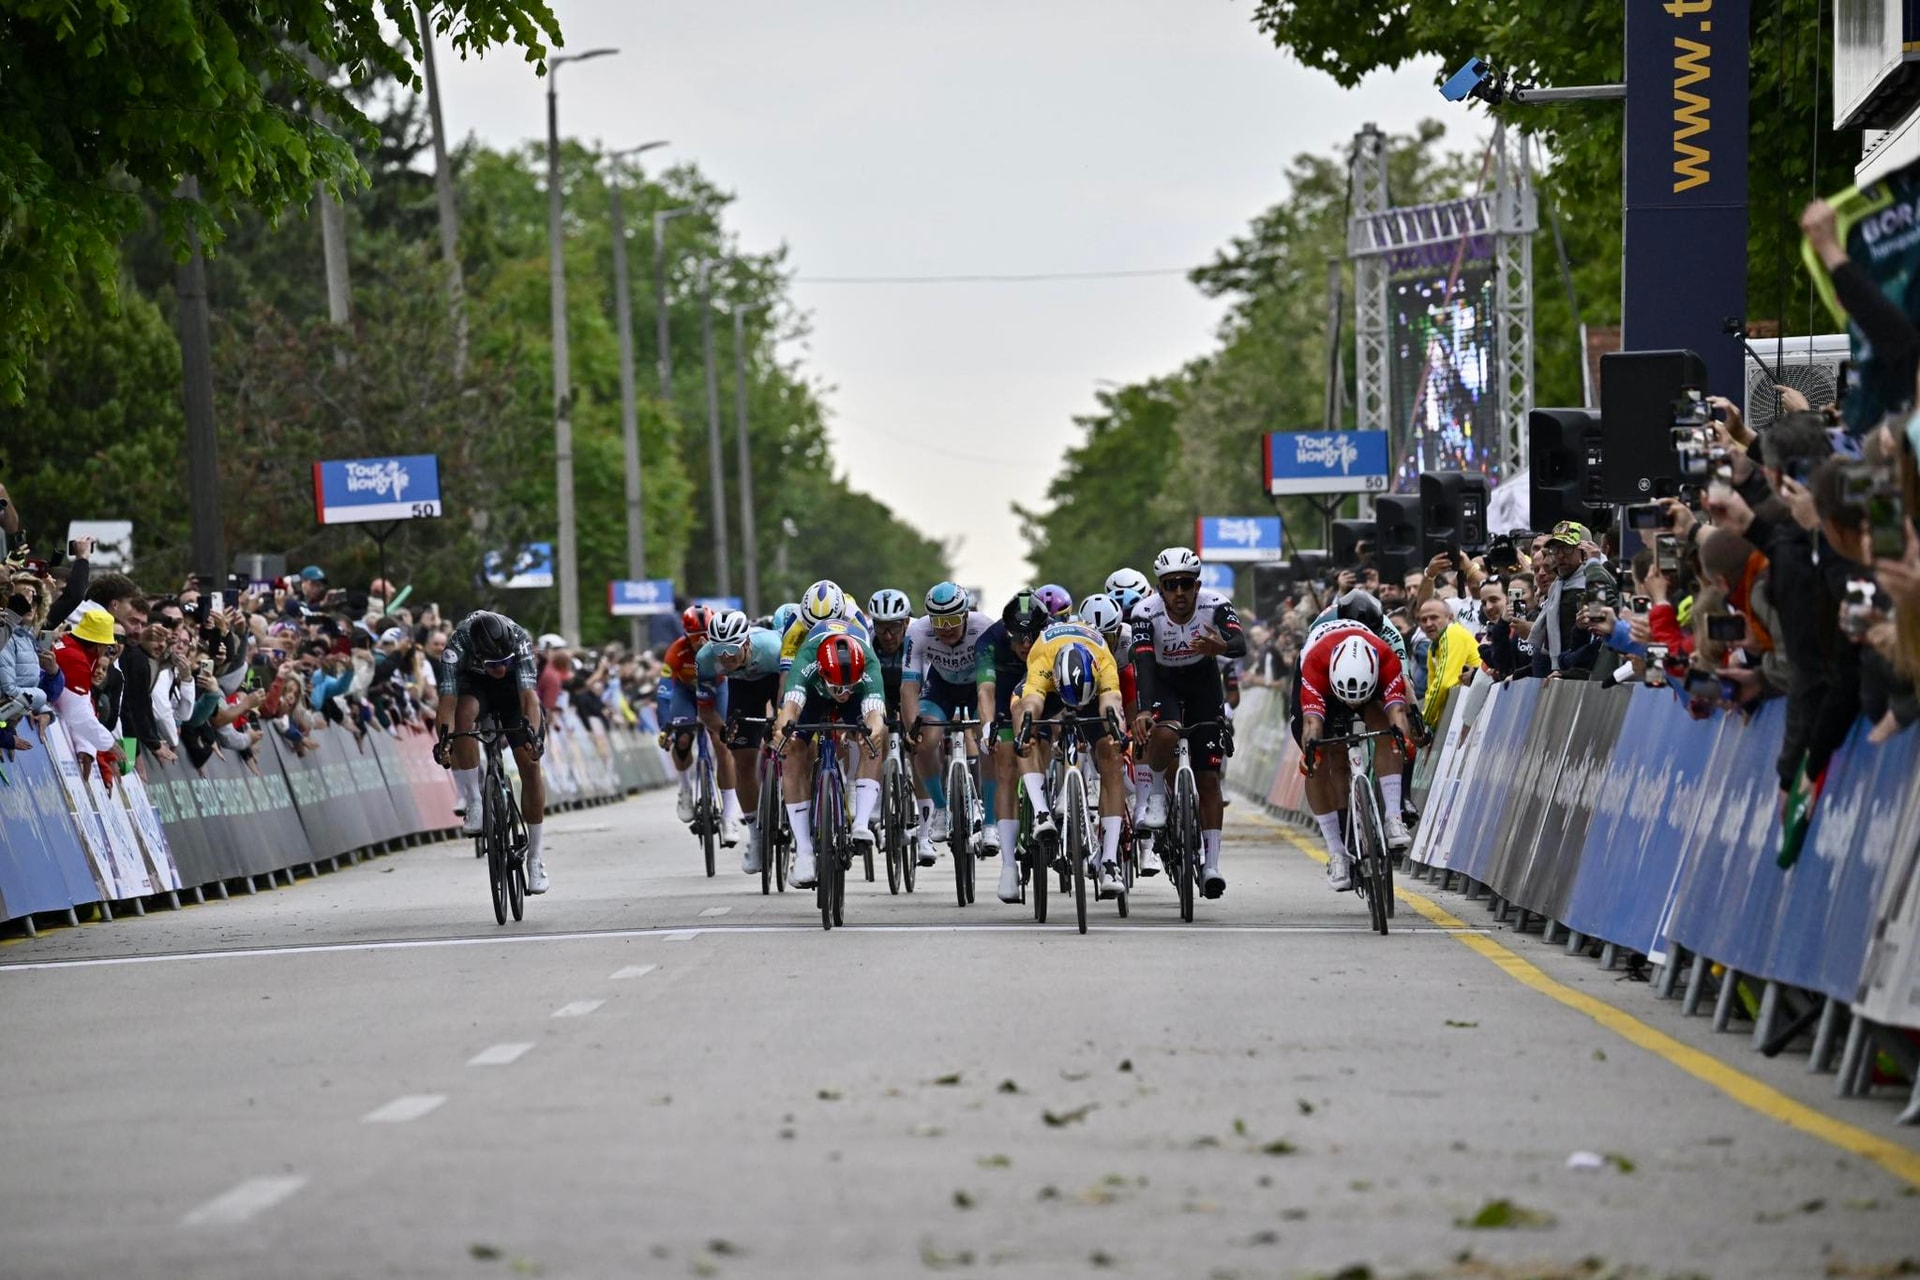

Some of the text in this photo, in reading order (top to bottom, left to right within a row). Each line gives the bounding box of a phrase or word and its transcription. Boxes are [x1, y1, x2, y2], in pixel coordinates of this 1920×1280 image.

[1294, 434, 1333, 449] Tour
[344, 461, 384, 477] Tour
[1365, 476, 1384, 489] 50
[411, 503, 435, 518] 50
